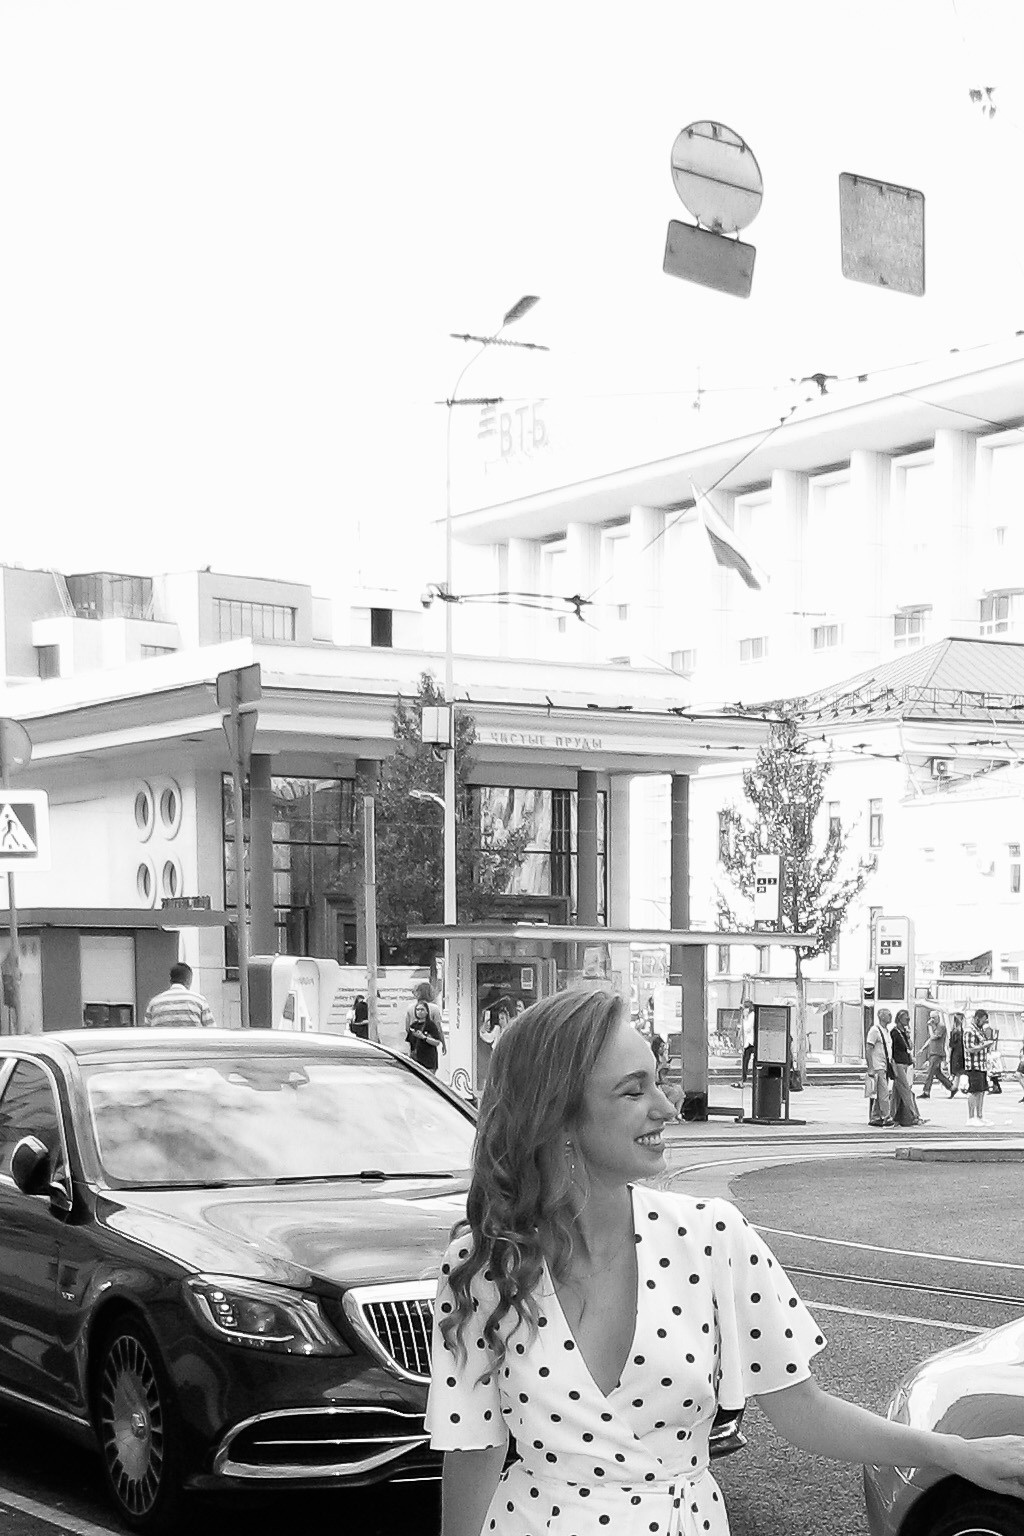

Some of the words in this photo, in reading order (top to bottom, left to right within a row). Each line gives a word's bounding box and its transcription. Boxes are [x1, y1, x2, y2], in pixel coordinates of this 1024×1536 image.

[500, 401, 547, 457] ВТБ
[490, 732, 545, 746] ЧИСТЫЕ
[555, 736, 602, 750] ПРУДЫ
